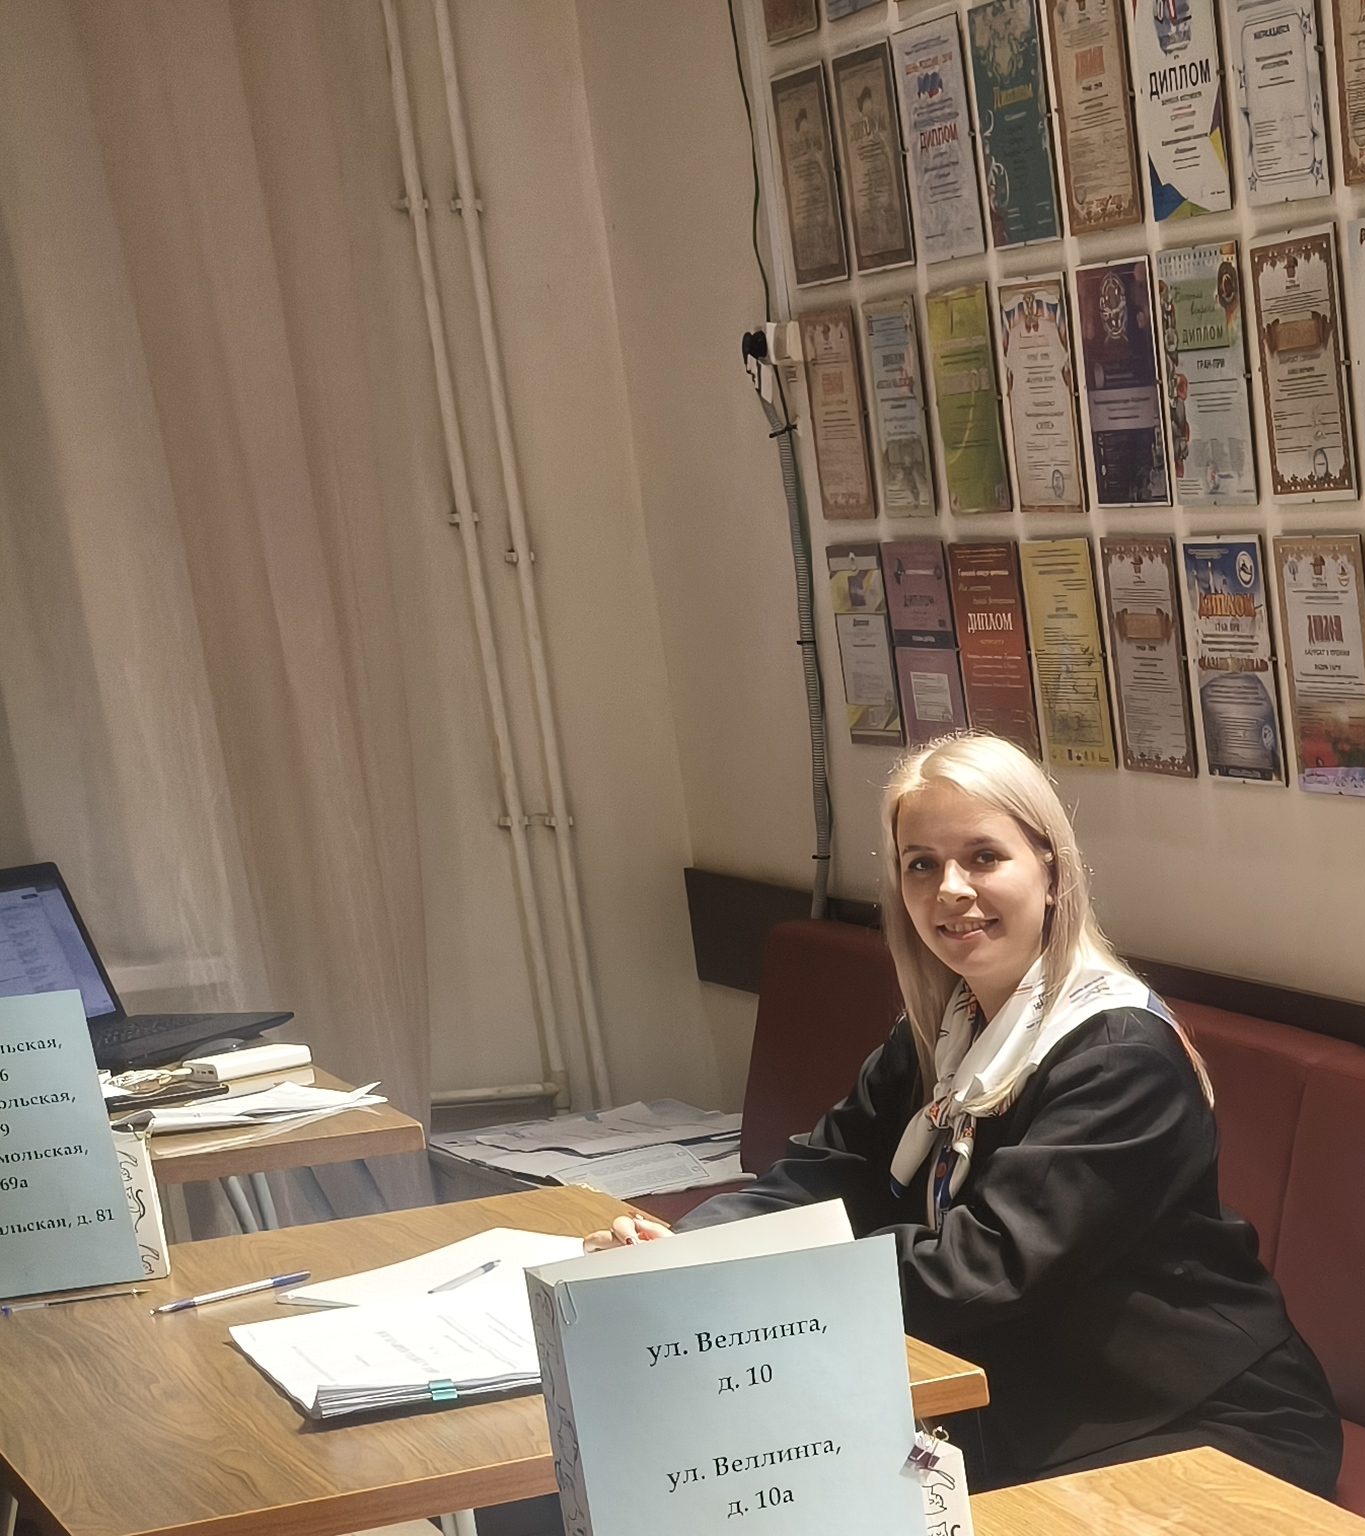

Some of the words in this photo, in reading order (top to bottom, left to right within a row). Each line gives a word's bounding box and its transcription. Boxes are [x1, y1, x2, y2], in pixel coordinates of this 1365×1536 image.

[1149, 57, 1211, 102] ДИПЛОМ
[919, 123, 960, 153] ДИПЛОМ
[1178, 325, 1224, 346] ДИПЛОМ
[967, 612, 1014, 634] ДИПЛОМ
[0, 1068, 9, 1082] 6
[0, 1123, 10, 1137] 9
[0, 1176, 29, 1191] 69а
[77, 1215, 93, 1227] д.
[95, 1208, 115, 1223] 81
[646, 1341, 688, 1368] ул.
[694, 1318, 827, 1353] Веллинга,
[718, 1376, 740, 1395] д.
[745, 1363, 773, 1387] 10
[666, 1467, 706, 1493] ул.
[712, 1439, 841, 1477] Веллинга,
[727, 1500, 749, 1519] д.
[755, 1486, 795, 1510] 10а
